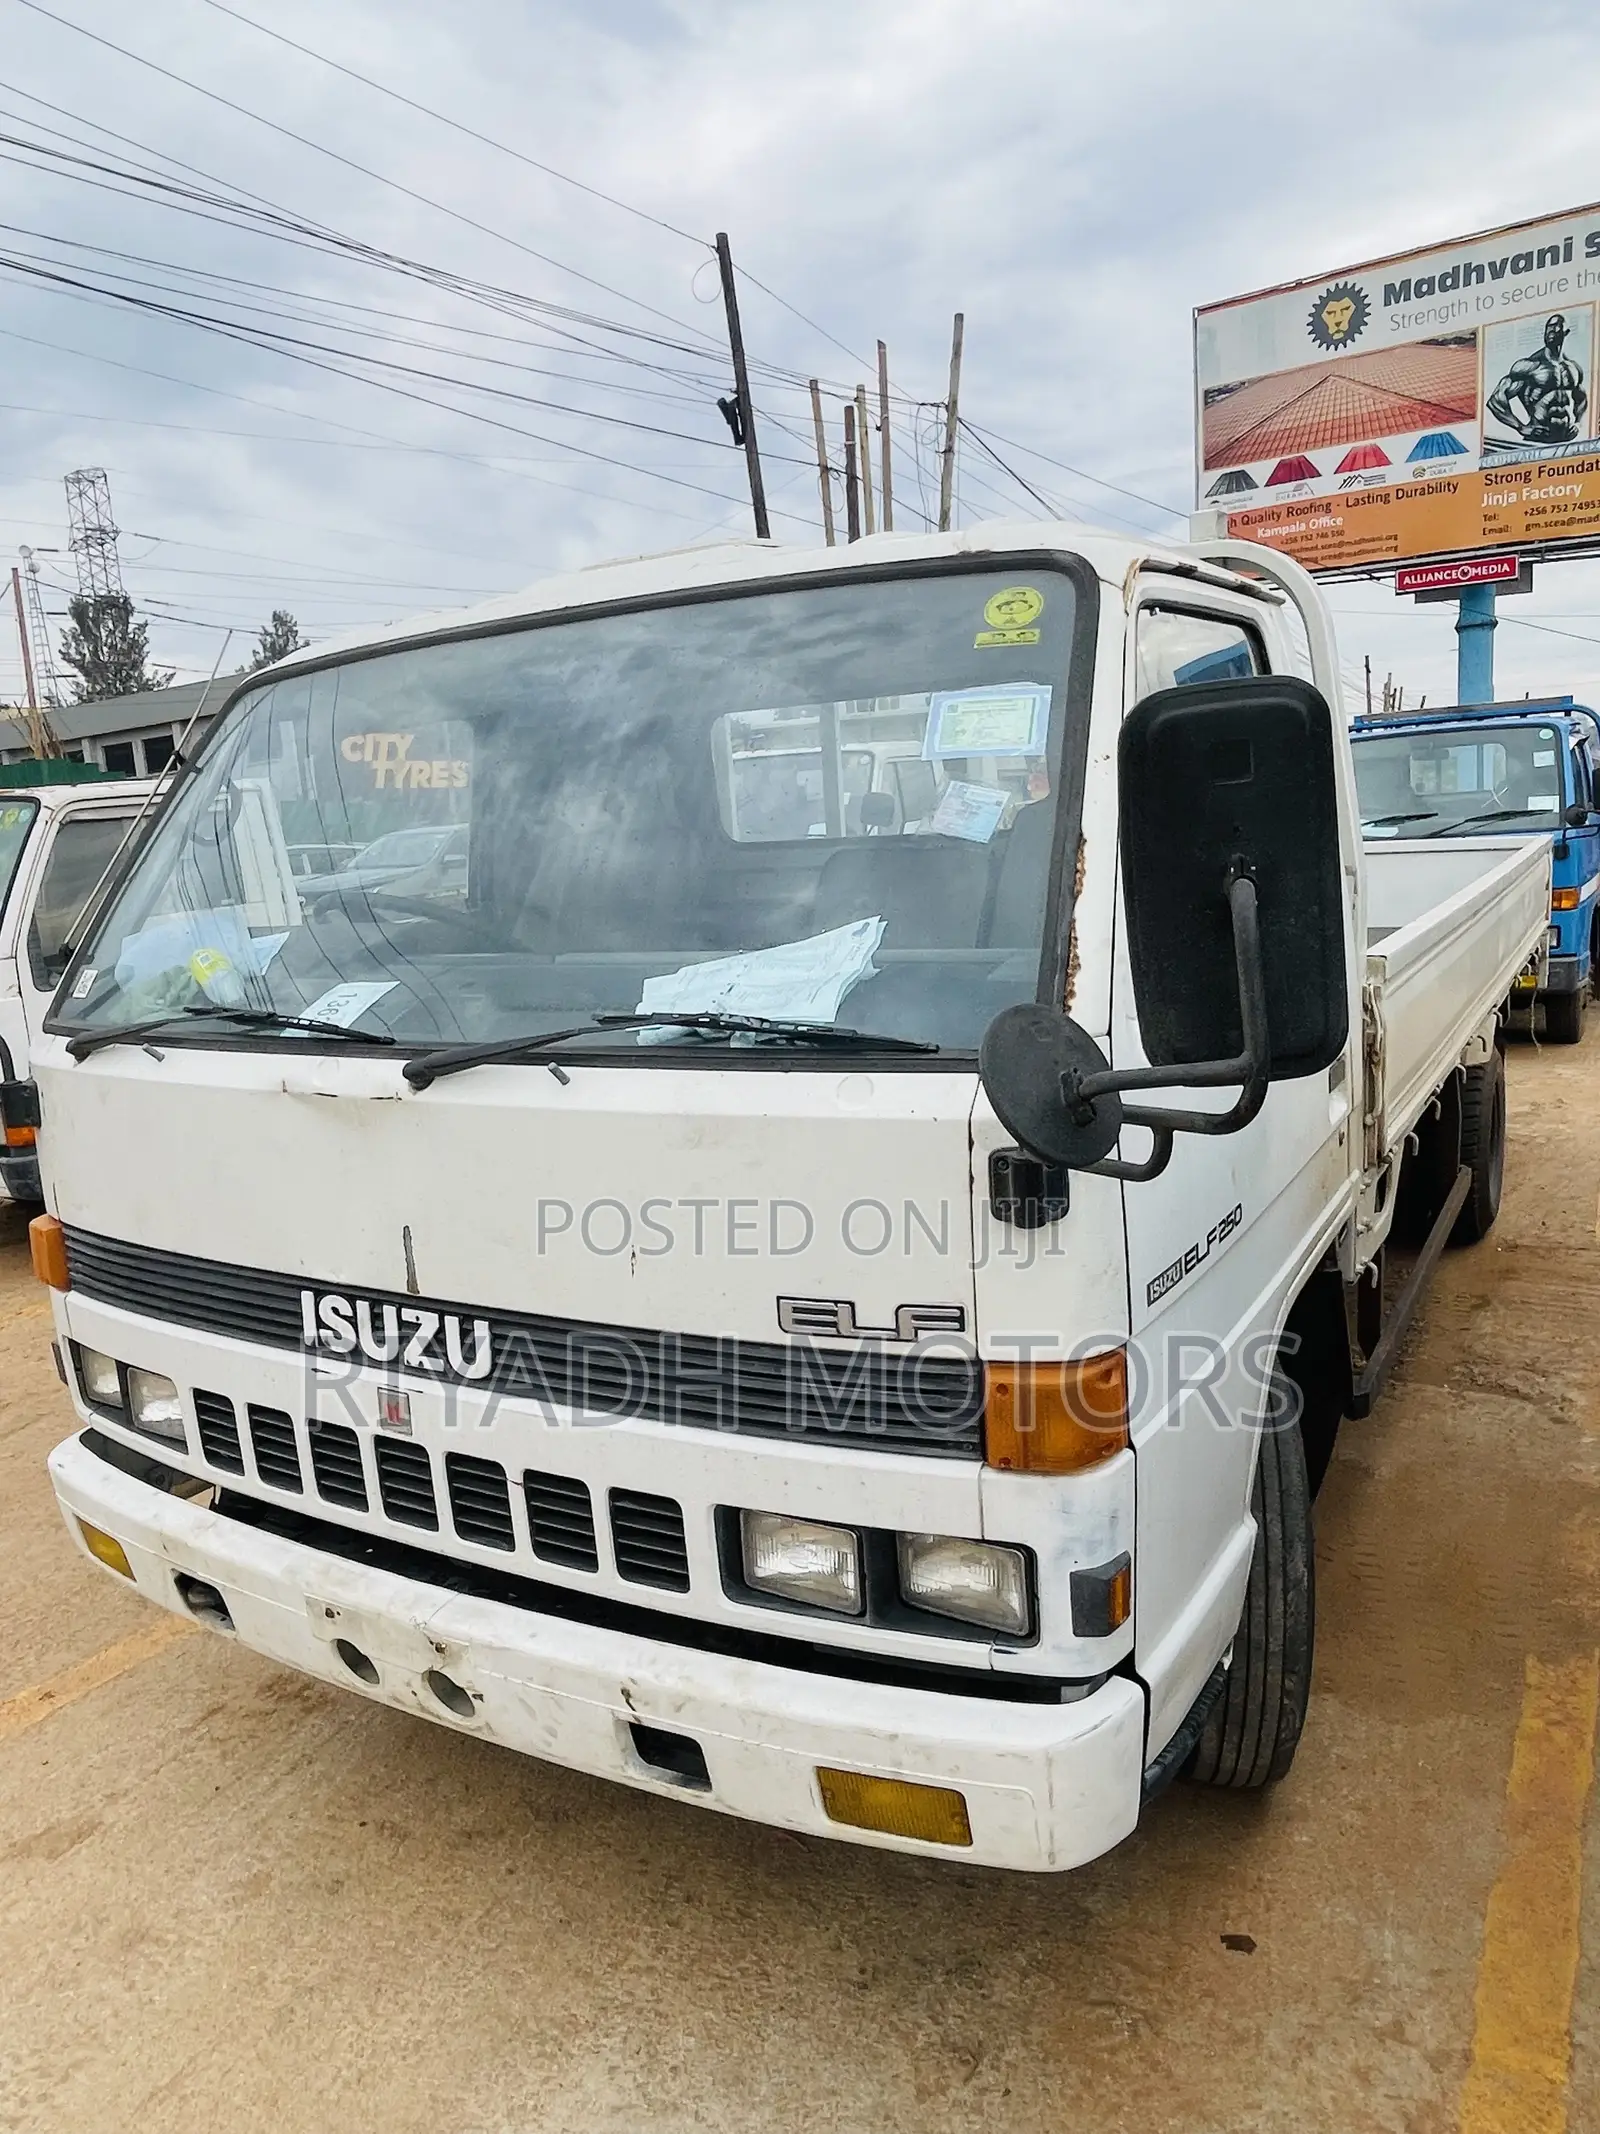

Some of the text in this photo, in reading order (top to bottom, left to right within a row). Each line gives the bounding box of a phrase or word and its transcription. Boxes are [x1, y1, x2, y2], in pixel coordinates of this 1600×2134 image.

[1384, 236, 1574, 307] Madhvani
[1390, 299, 1468, 331] Strength
[1476, 295, 1494, 311] to
[1501, 277, 1569, 305] secure
[1484, 470, 1532, 487] Strong
[1241, 510, 1282, 527] Quality
[1286, 501, 1332, 519] Roofing
[1345, 493, 1391, 509] Lasting
[1395, 480, 1459, 500] Durability
[1481, 483, 1583, 507] Jinja Factory
[1257, 515, 1344, 539] Kampala Office
[1483, 513, 1499, 522] Tel:
[1524, 505, 1547, 516] +256
[1551, 503, 1568, 513] 752
[1403, 563, 1510, 585] ALLIANCE MEDIA
[340, 733, 415, 762] CITY
[373, 760, 469, 788] TYRES
[1150, 1261, 1181, 1302] ISUZU
[777, 1296, 966, 1342] ELF
[300, 1289, 493, 1380] ISUZU
